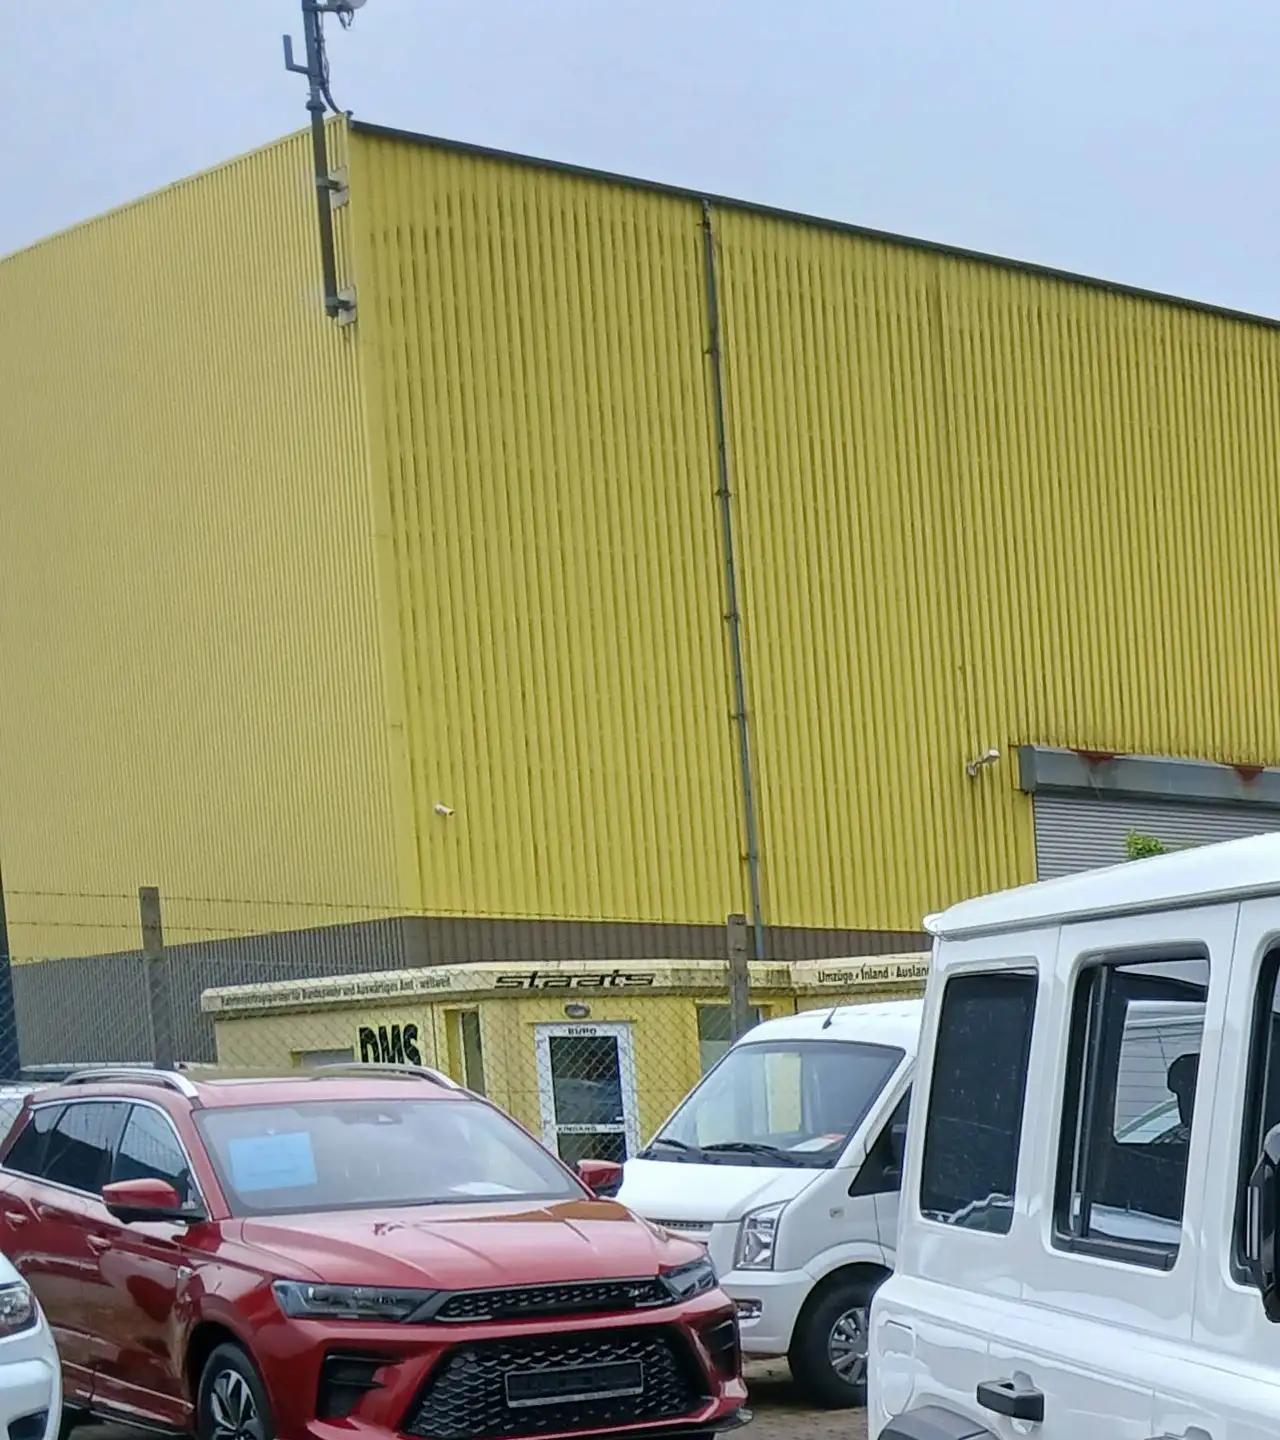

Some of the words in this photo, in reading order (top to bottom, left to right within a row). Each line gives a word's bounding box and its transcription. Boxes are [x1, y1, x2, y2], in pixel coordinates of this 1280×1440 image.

[494, 969, 656, 988] staats
[860, 964, 888, 981] Inland
[359, 1023, 422, 1066] DMS
